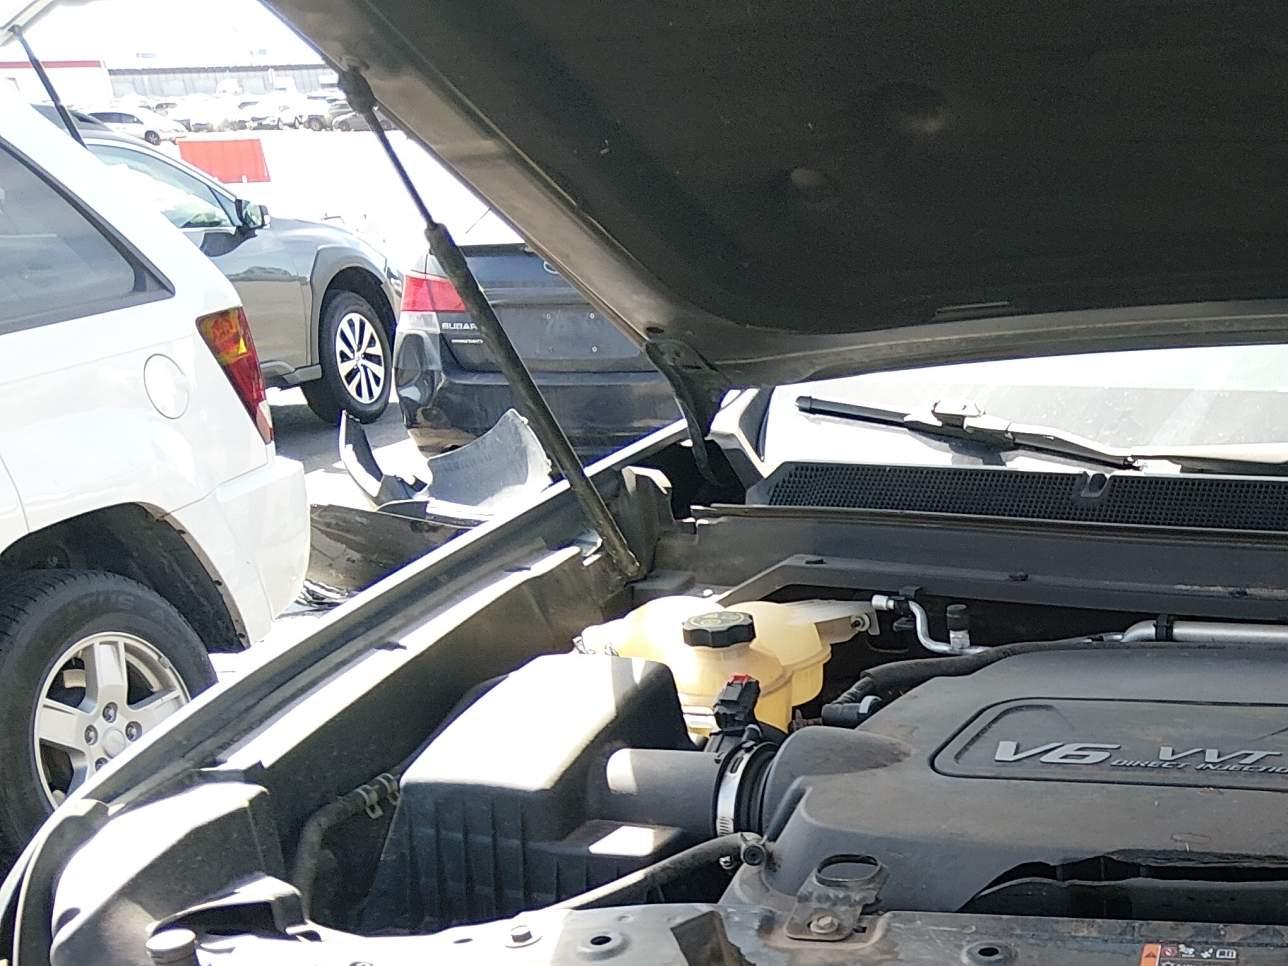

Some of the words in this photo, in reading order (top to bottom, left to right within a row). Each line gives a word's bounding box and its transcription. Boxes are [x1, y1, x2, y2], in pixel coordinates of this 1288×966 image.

[441, 322, 478, 330] SUBAR
[994, 740, 1122, 765] V6
[1158, 745, 1283, 765] VVT
[1110, 758, 1191, 769] DIRECT
